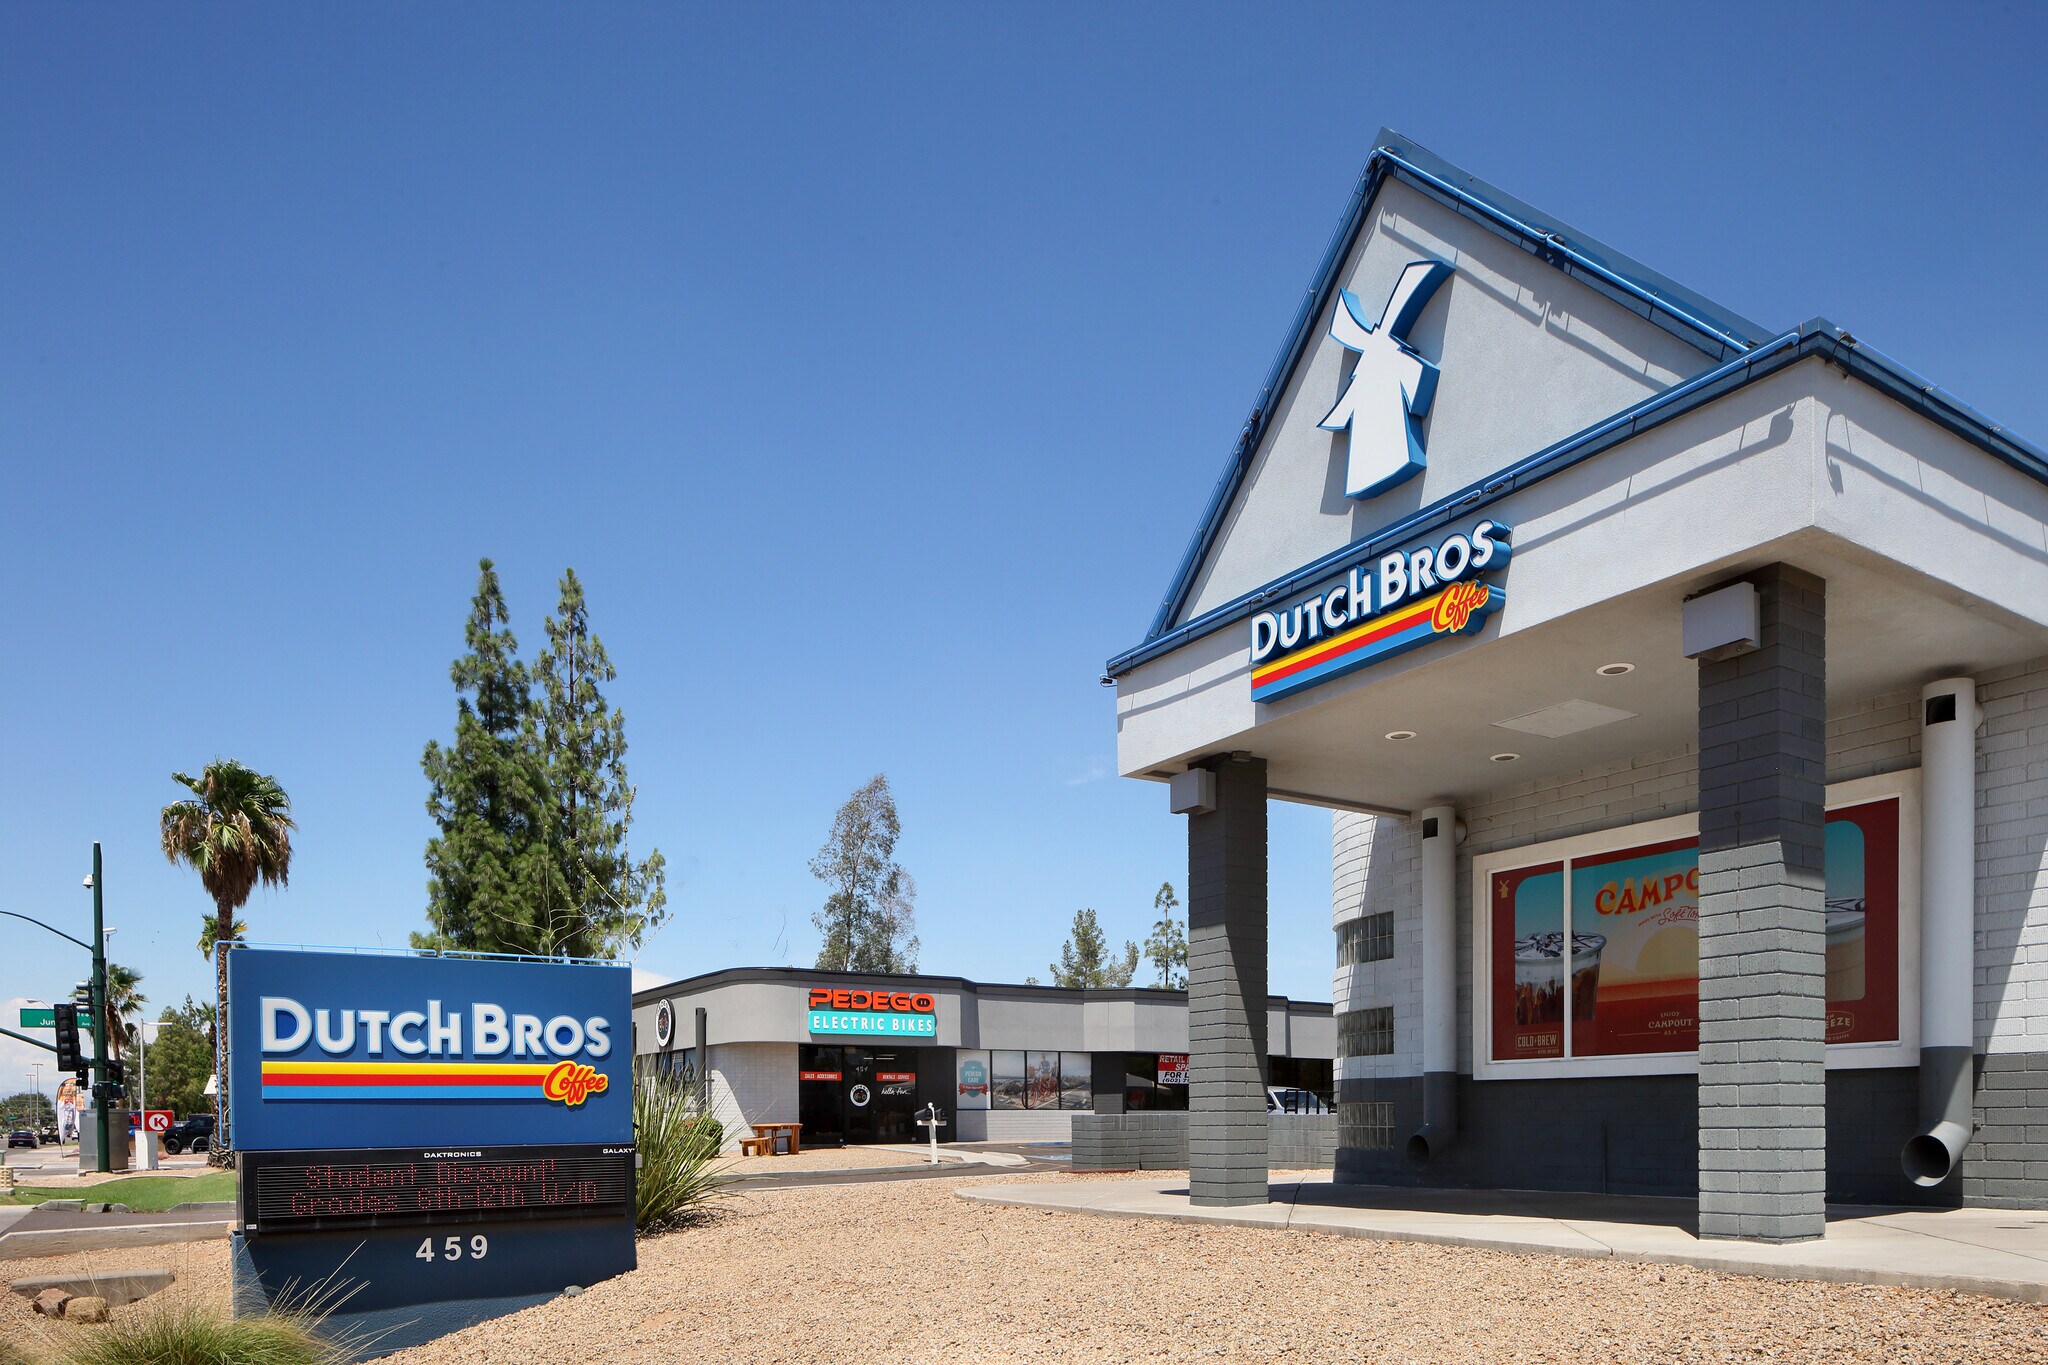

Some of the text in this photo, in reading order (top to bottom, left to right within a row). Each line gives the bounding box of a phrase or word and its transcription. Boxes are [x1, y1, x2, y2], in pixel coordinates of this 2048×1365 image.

[1250, 519, 1497, 663] DUTCH BROS
[1432, 583, 1490, 630] Coffee
[1595, 867, 1699, 915] CAMPO
[1657, 907, 1686, 926] Soft
[810, 988, 935, 1012] PEDEGO
[40, 1018, 56, 1027] Jun
[260, 995, 612, 1058] DUTCH BROS
[813, 1015, 932, 1032] ELECTRIC BIKES
[1648, 1018, 1694, 1029] CAMPOUT
[1825, 1017, 1850, 1029] EEZE
[1517, 1034, 1557, 1047] COLD BREW
[544, 1063, 606, 1104] Coffee
[154, 1117, 165, 1130] K
[423, 1151, 482, 1159] DAKTRONICS
[305, 1163, 417, 1189] Student
[291, 1190, 398, 1215] Grades
[418, 1184, 524, 1209] 6th-12th
[415, 1234, 488, 1262] 459
